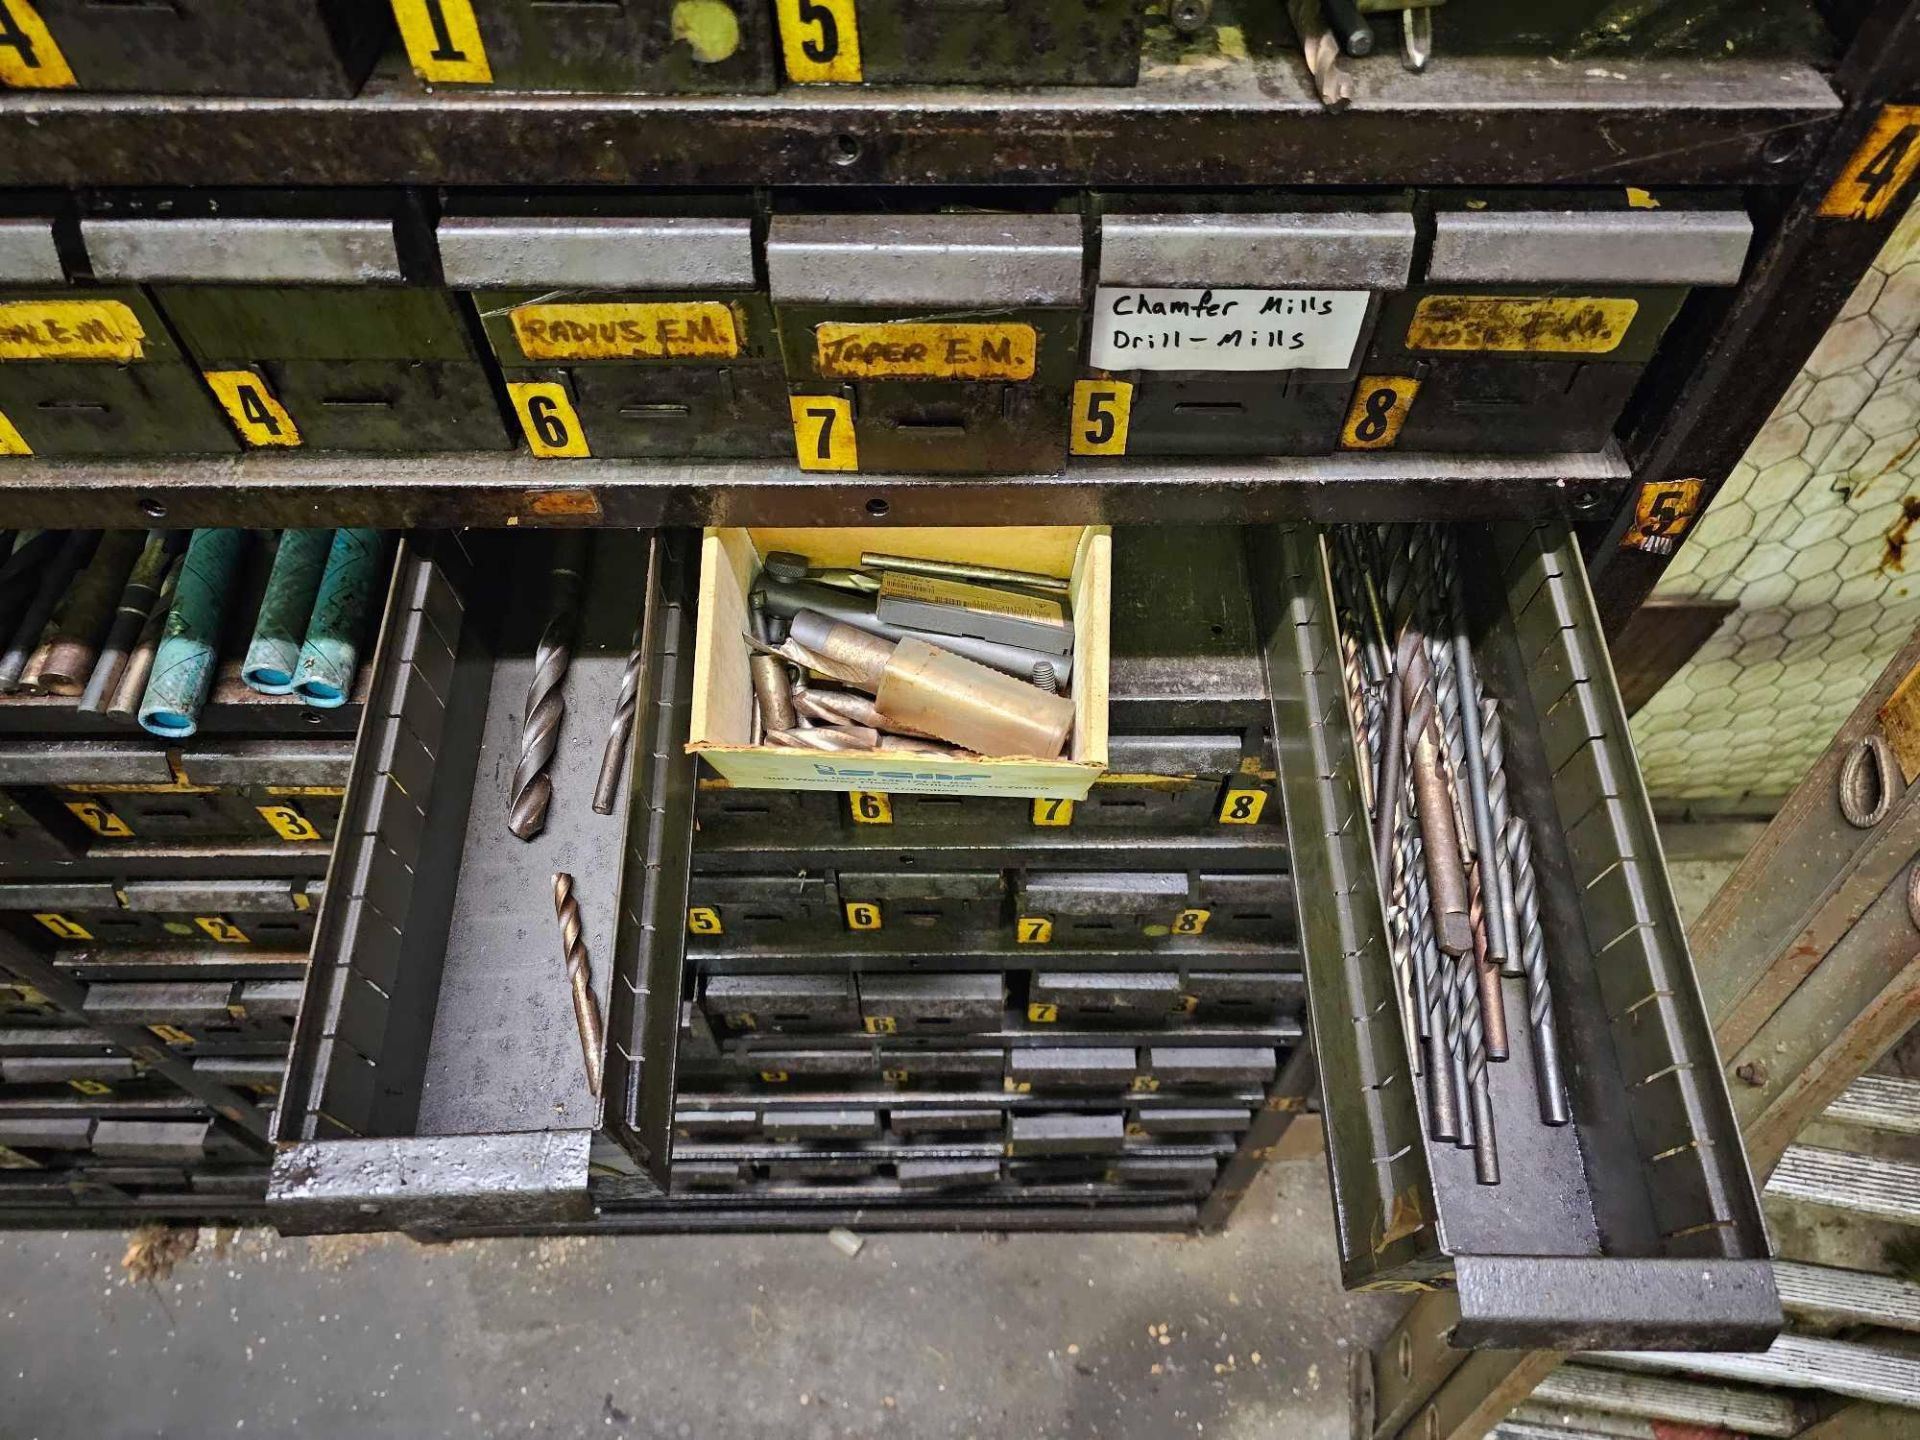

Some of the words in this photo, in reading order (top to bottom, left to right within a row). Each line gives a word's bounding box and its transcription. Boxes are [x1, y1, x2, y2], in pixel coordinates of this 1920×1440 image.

[800, 0, 838, 63] 5
[1855, 124, 1920, 203] 4
[1112, 290, 1239, 318] Chamfer
[1259, 296, 1333, 316] Mills
[520, 317, 647, 345] RADIUS
[822, 334, 928, 365] TAPER
[237, 385, 282, 436] 4
[527, 395, 568, 448] 6
[1085, 392, 1116, 444] 5
[1355, 388, 1397, 442] 8
[806, 408, 836, 460] 7
[1641, 491, 1684, 536] 5
[84, 806, 120, 832] 2
[859, 794, 881, 819] 6
[1044, 798, 1063, 821] 7
[1230, 795, 1255, 819] 8
[277, 811, 307, 835] 3
[49, 917, 81, 936] 1
[693, 912, 713, 930] 5
[854, 907, 874, 925] 6
[1178, 914, 1199, 931] 8
[208, 920, 240, 939] 2
[1027, 922, 1044, 940] 7
[874, 1018, 890, 1031] 6
[1036, 1006, 1051, 1019] 7
